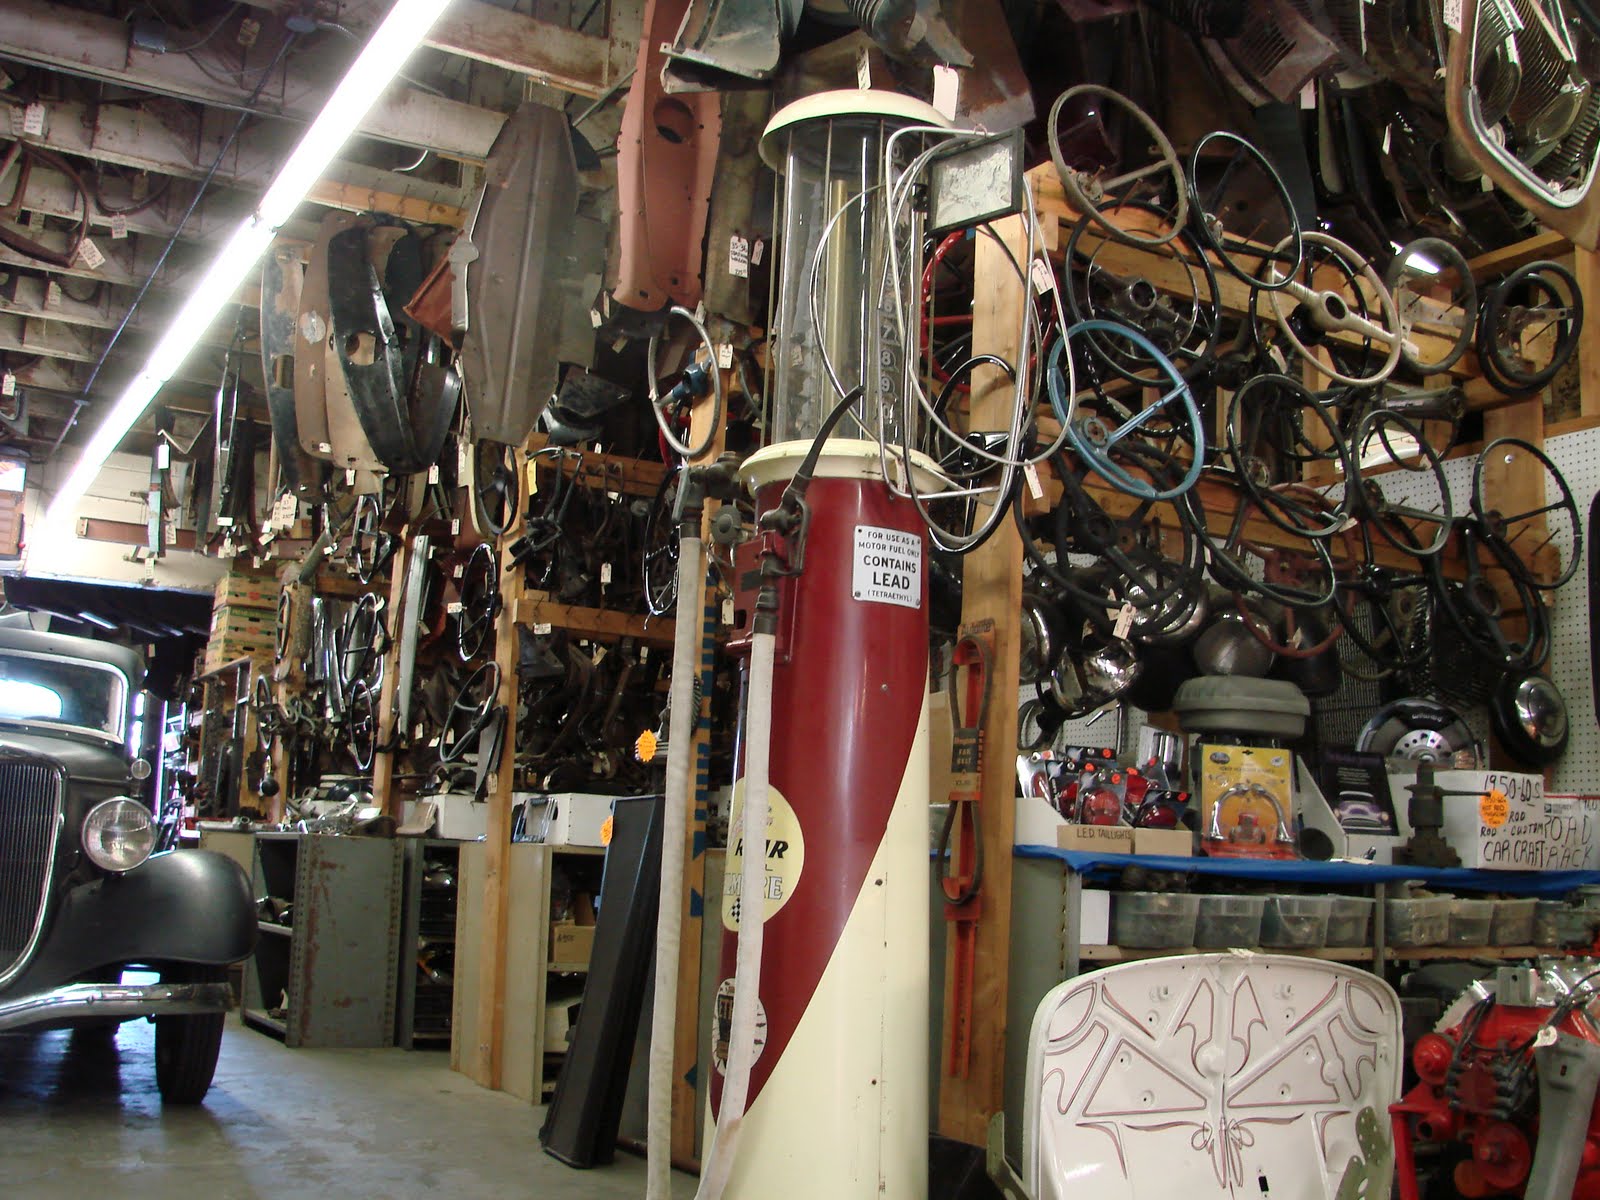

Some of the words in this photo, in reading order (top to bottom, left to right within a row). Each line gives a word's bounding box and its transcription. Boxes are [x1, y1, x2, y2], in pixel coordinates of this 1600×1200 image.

[882, 324, 892, 339] 7
[881, 351, 891, 365] 8
[881, 377, 890, 392] 9
[867, 531, 883, 540] FOR
[886, 533, 900, 543] USE
[901, 537, 910, 545] AS
[858, 542, 887, 551] MOTOR
[889, 545, 905, 555] FUEL
[906, 549, 920, 558] ONLY
[863, 555, 917, 574] CONTAINS
[872, 571, 910, 590] LEAD
[1508, 811, 1526, 823] ROD
[1480, 826, 1497, 837] ROD
[1483, 839, 1510, 863] CAR
[1513, 839, 1546, 868] CRAFT
